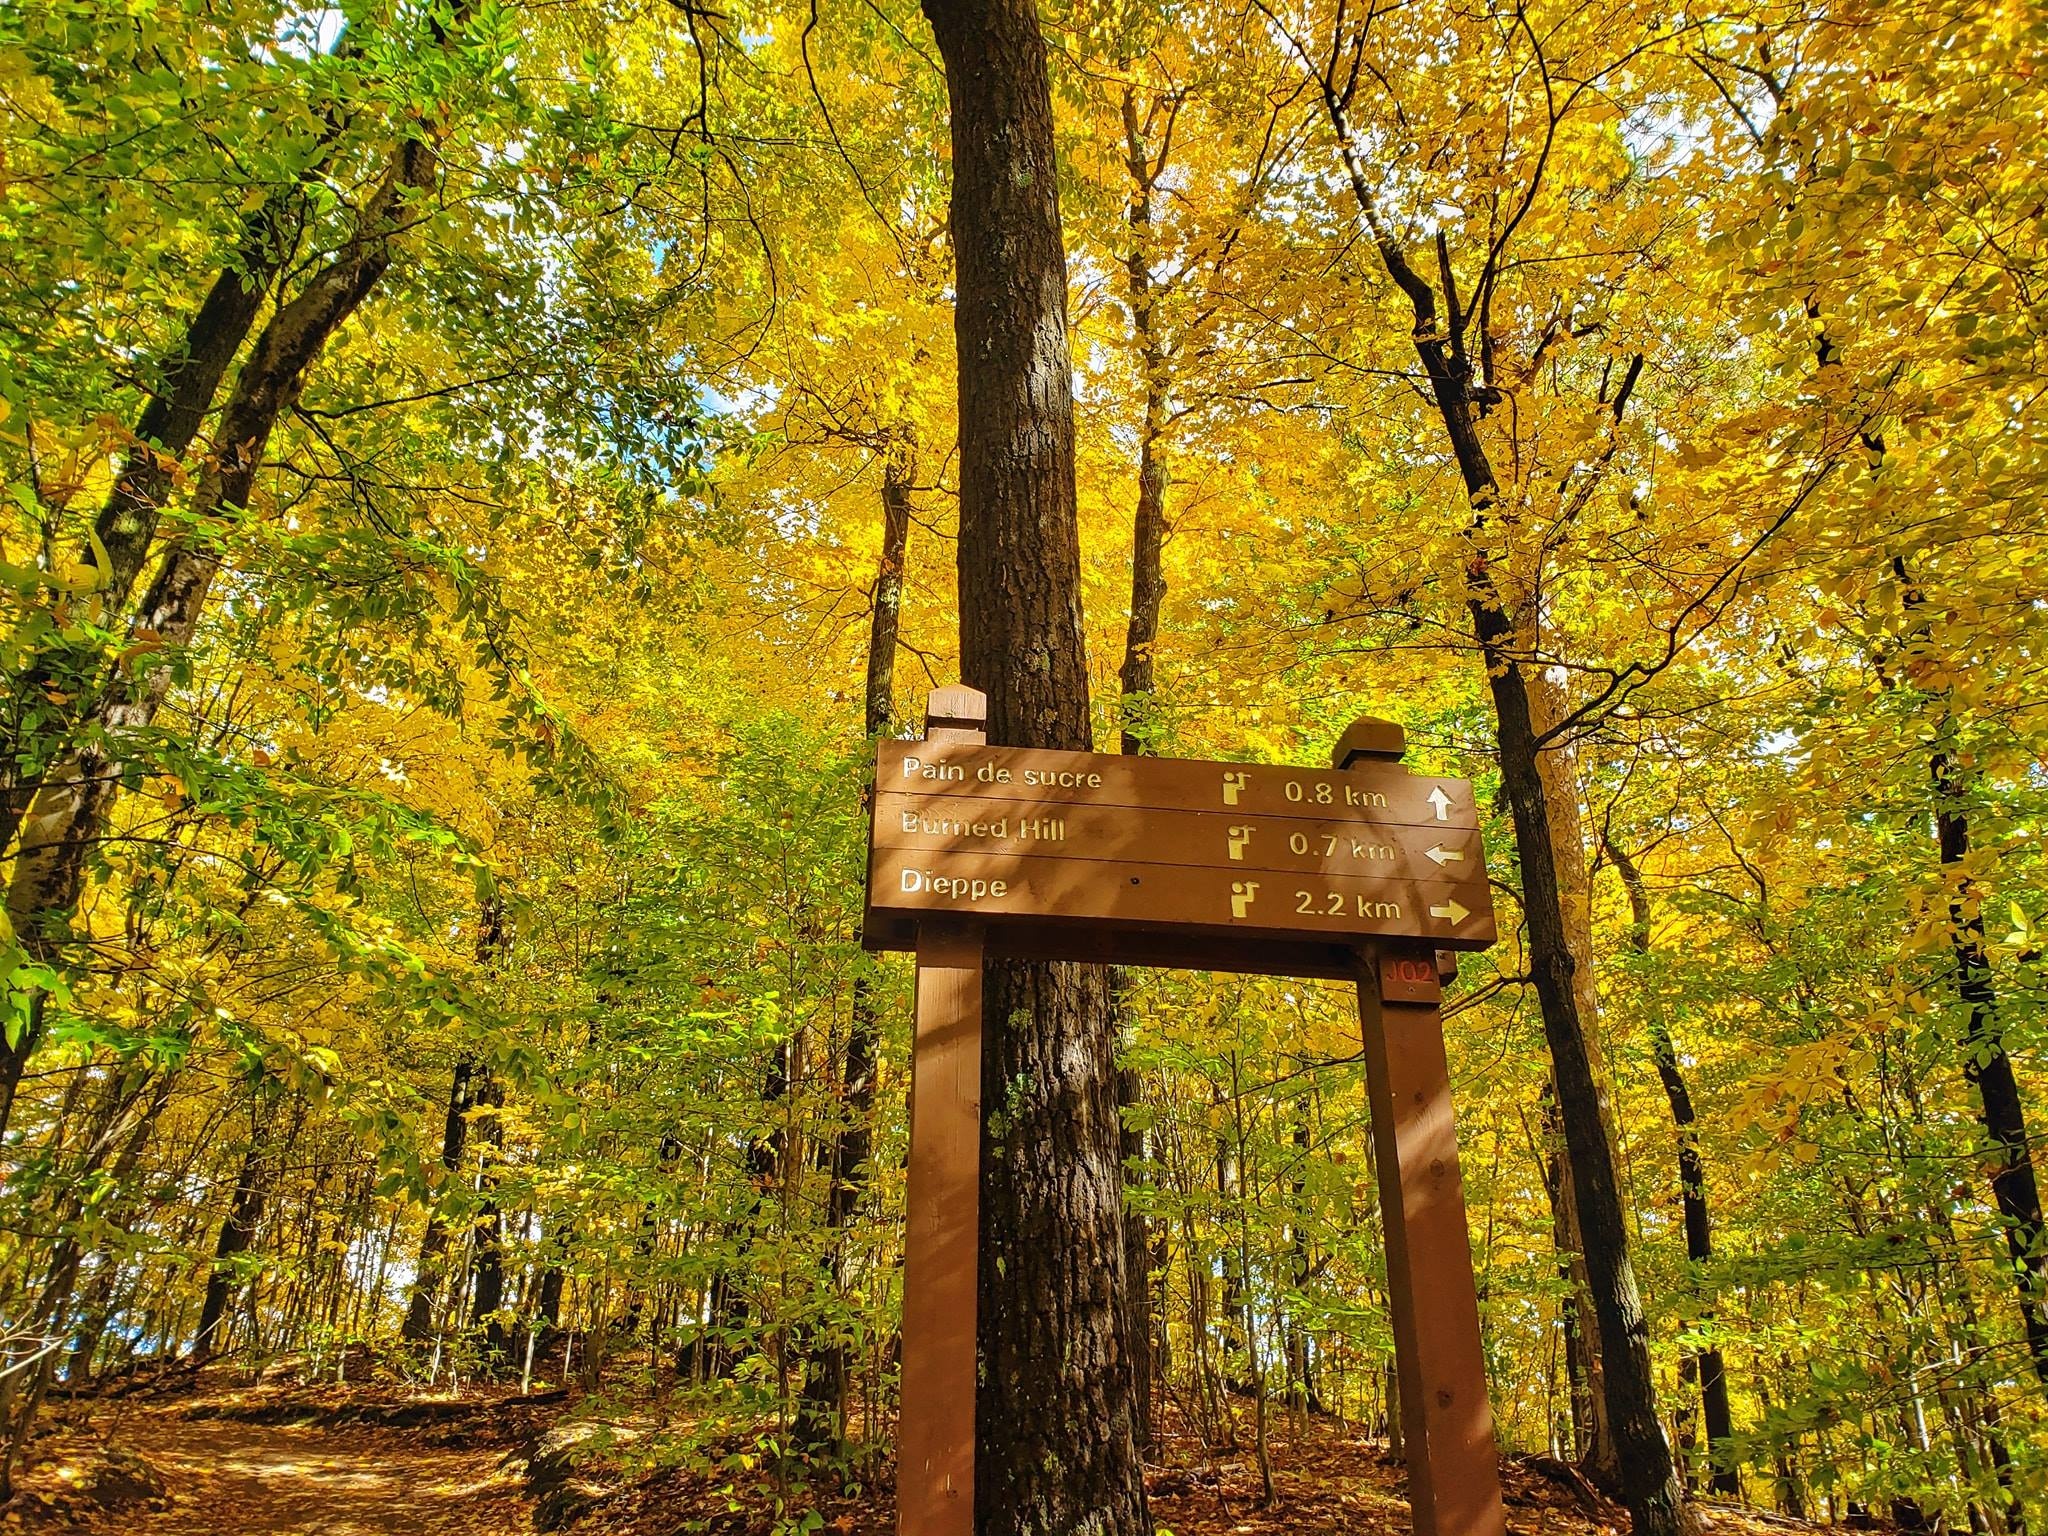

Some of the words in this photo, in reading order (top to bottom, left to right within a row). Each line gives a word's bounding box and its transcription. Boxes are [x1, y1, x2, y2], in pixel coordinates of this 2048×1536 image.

[903, 756, 964, 782] Pain
[977, 761, 1012, 784] de
[1024, 768, 1103, 788] sucre
[1285, 781, 1334, 805] 0.8
[1345, 785, 1388, 808] km
[902, 810, 1007, 838] Burned
[1019, 818, 1065, 841] Hill
[1289, 832, 1338, 857] 0.7
[1352, 840, 1395, 860] km
[900, 868, 1008, 901] Dieppe
[1295, 891, 1347, 917] 2.2
[1357, 895, 1401, 919] km
